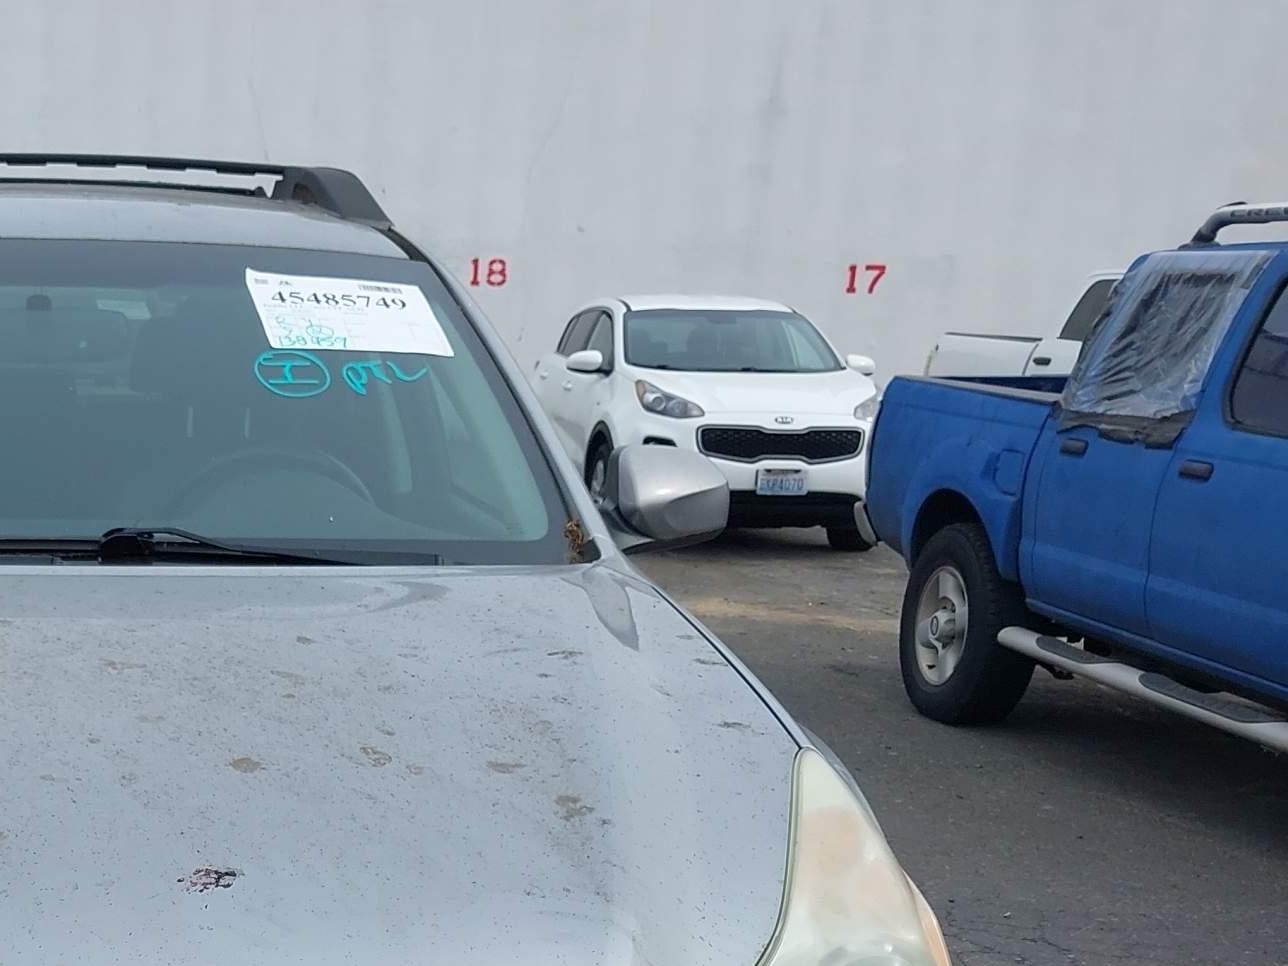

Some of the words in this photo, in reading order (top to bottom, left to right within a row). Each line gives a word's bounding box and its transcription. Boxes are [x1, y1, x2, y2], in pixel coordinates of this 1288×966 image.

[470, 258, 507, 287] 18
[845, 264, 887, 294] 17
[271, 290, 407, 311] 45485749
